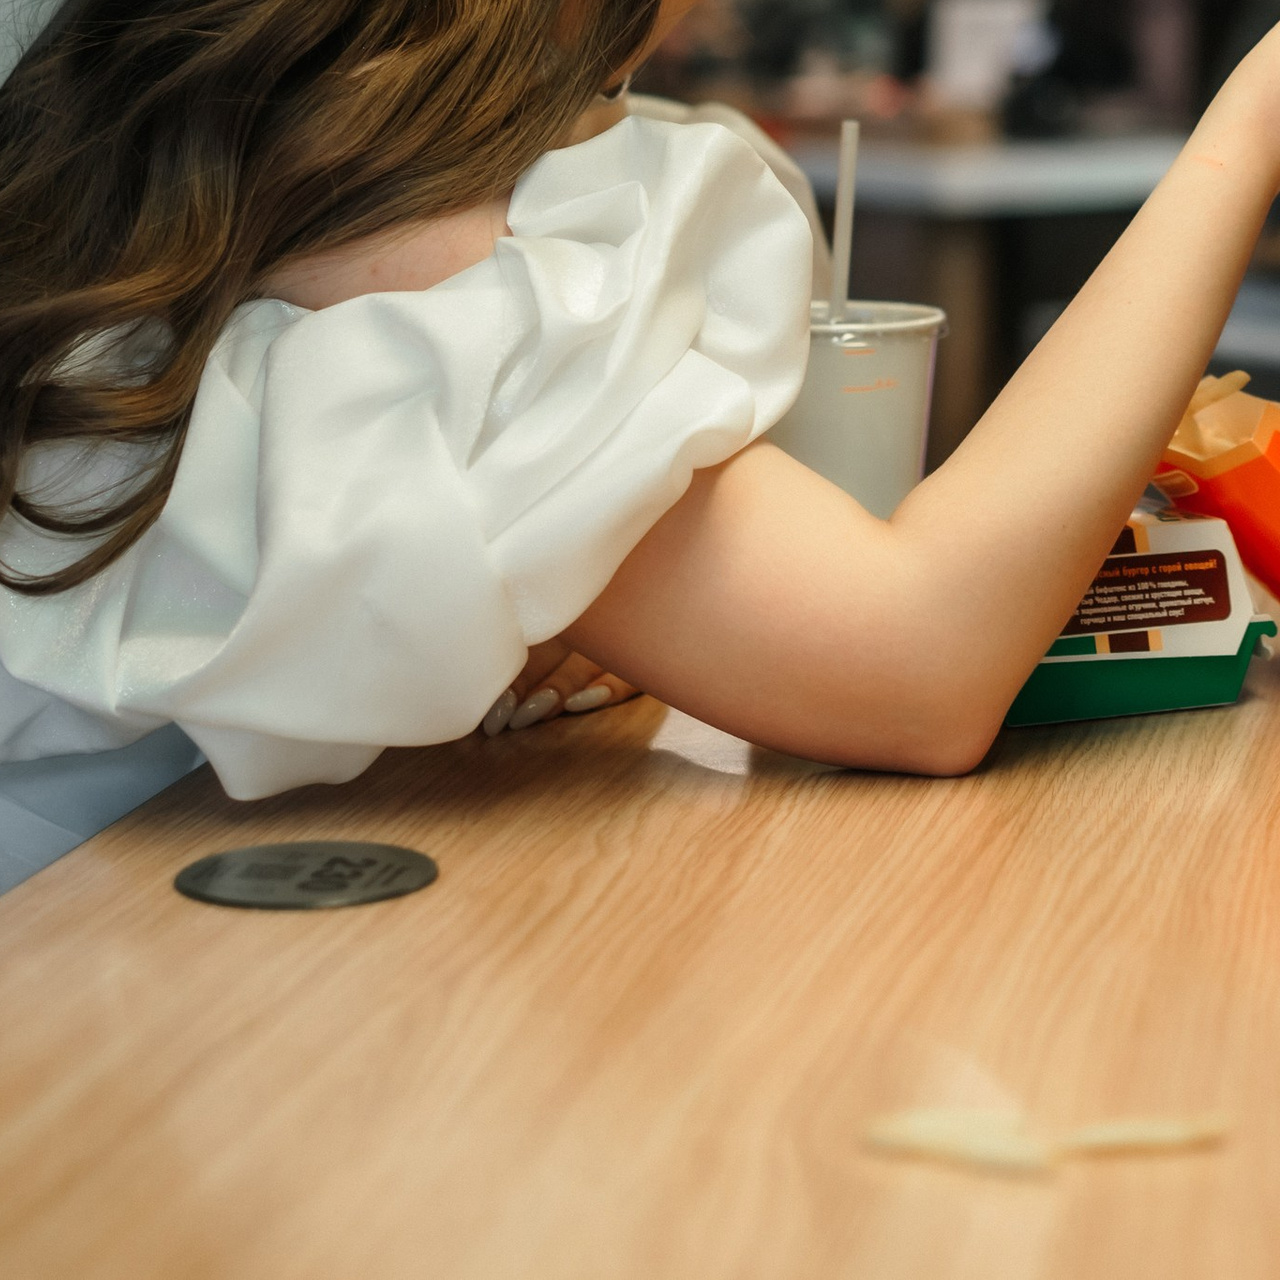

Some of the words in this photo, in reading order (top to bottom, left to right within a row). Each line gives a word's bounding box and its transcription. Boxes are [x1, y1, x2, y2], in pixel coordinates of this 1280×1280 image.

[1097, 567, 1120, 578] сный
[1122, 565, 1150, 578] бургер
[1151, 565, 1157, 574] с
[1158, 561, 1182, 574] горой
